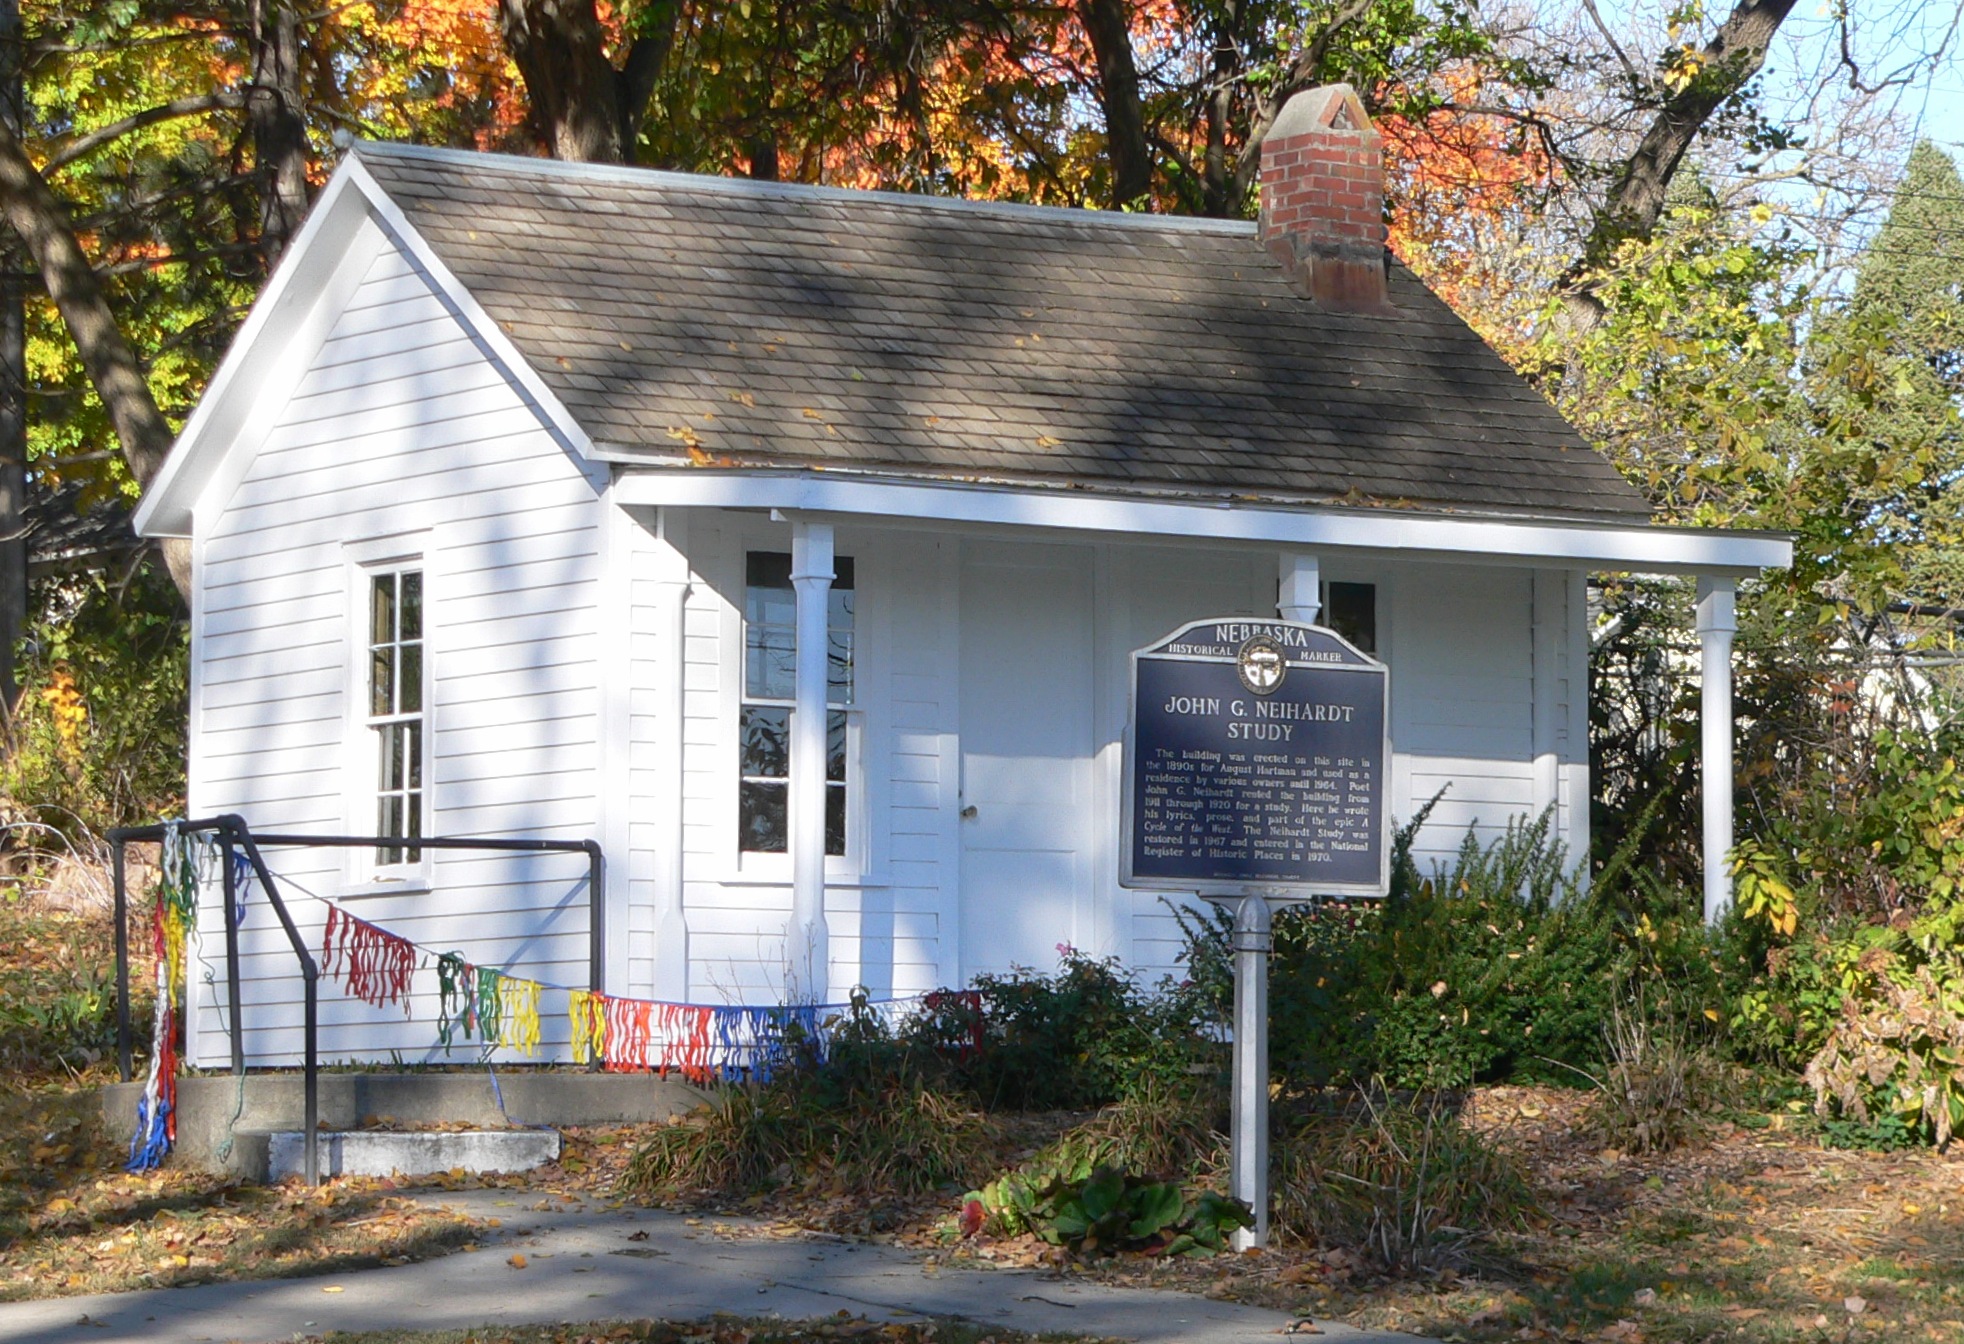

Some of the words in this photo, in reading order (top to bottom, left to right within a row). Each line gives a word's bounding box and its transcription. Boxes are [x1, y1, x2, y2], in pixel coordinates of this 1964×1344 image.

[1216, 624, 1308, 648] NEBRASKA
[1168, 643, 1234, 656] HISTORICAL
[1300, 651, 1342, 662] MARKER
[1164, 696, 1220, 715] JOHN
[1231, 700, 1248, 717] G.
[1256, 700, 1354, 722] NEIHARDT
[1228, 722, 1293, 742] STUDY
[1156, 748, 1174, 758] The
[1182, 750, 1221, 762] building
[1254, 754, 1288, 764] erected
[1314, 756, 1330, 765] this
[1338, 757, 1354, 766] site
[1362, 758, 1370, 767] in
[1146, 761, 1160, 769] the
[1166, 761, 1194, 771] 1890s
[1201, 762, 1214, 772] for
[1220, 764, 1252, 775] August
[1257, 766, 1296, 776] Hartman
[1301, 768, 1317, 776] and
[1323, 769, 1343, 778] used
[1146, 774, 1190, 783] residence
[1196, 775, 1207, 786] by
[1214, 776, 1247, 786] various
[1290, 780, 1309, 788] until
[1349, 782, 1370, 791] Poet
[1145, 785, 1168, 794] John
[1194, 787, 1234, 797] Neihardt
[1242, 790, 1271, 799] rented
[1280, 792, 1294, 800] the
[1302, 792, 1340, 804] building
[1348, 794, 1370, 803] from
[1166, 798, 1204, 810] through
[1209, 800, 1230, 809] 1920
[1236, 801, 1250, 810] for
[1264, 803, 1292, 814] study.
[1302, 804, 1324, 813] Here
[1328, 806, 1339, 814] he
[1344, 807, 1369, 815] wrote
[1144, 809, 1158, 818] his
[1243, 814, 1260, 822] and
[1268, 816, 1288, 826] part
[1294, 816, 1304, 824] of
[1312, 816, 1326, 826] the
[1334, 818, 1354, 828] epic
[1362, 818, 1368, 827] A
[1144, 821, 1166, 832] Cycle
[1174, 823, 1184, 831] of
[1191, 823, 1203, 832] the
[1243, 825, 1261, 835] The
[1270, 826, 1310, 837] Neihardt
[1318, 829, 1344, 840] Study
[1144, 835, 1183, 844] restored
[1190, 836, 1198, 844] in
[1204, 836, 1226, 846] 1967
[1230, 838, 1247, 847] and
[1254, 839, 1288, 848] entered
[1295, 840, 1304, 848] in
[1310, 840, 1324, 850] the
[1331, 842, 1368, 852] National
[1144, 846, 1184, 858] Register
[1192, 848, 1202, 856] of
[1210, 848, 1247, 858] Historic
[1254, 850, 1284, 860] Places
[1291, 851, 1300, 860] in
